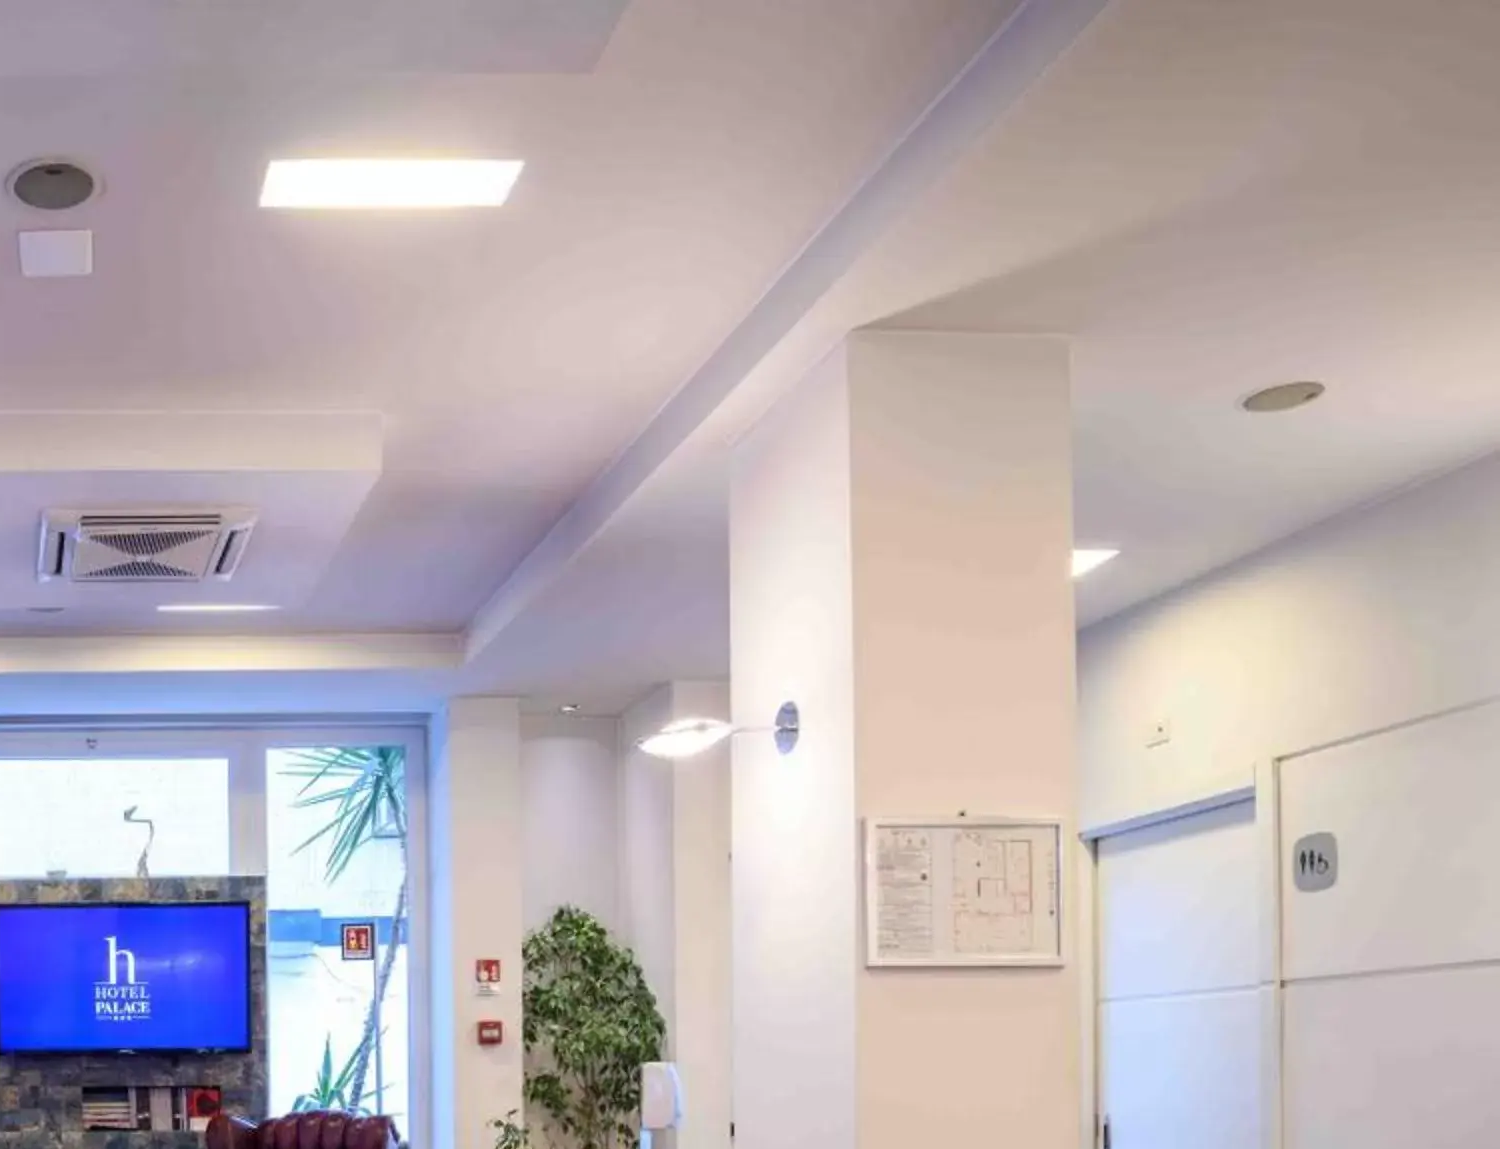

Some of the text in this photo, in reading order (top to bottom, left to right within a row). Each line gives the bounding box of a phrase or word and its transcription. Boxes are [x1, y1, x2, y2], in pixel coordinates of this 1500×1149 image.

[103, 935, 136, 984] h
[95, 986, 150, 999] HOTEL
[95, 1001, 151, 1014] PALACE
